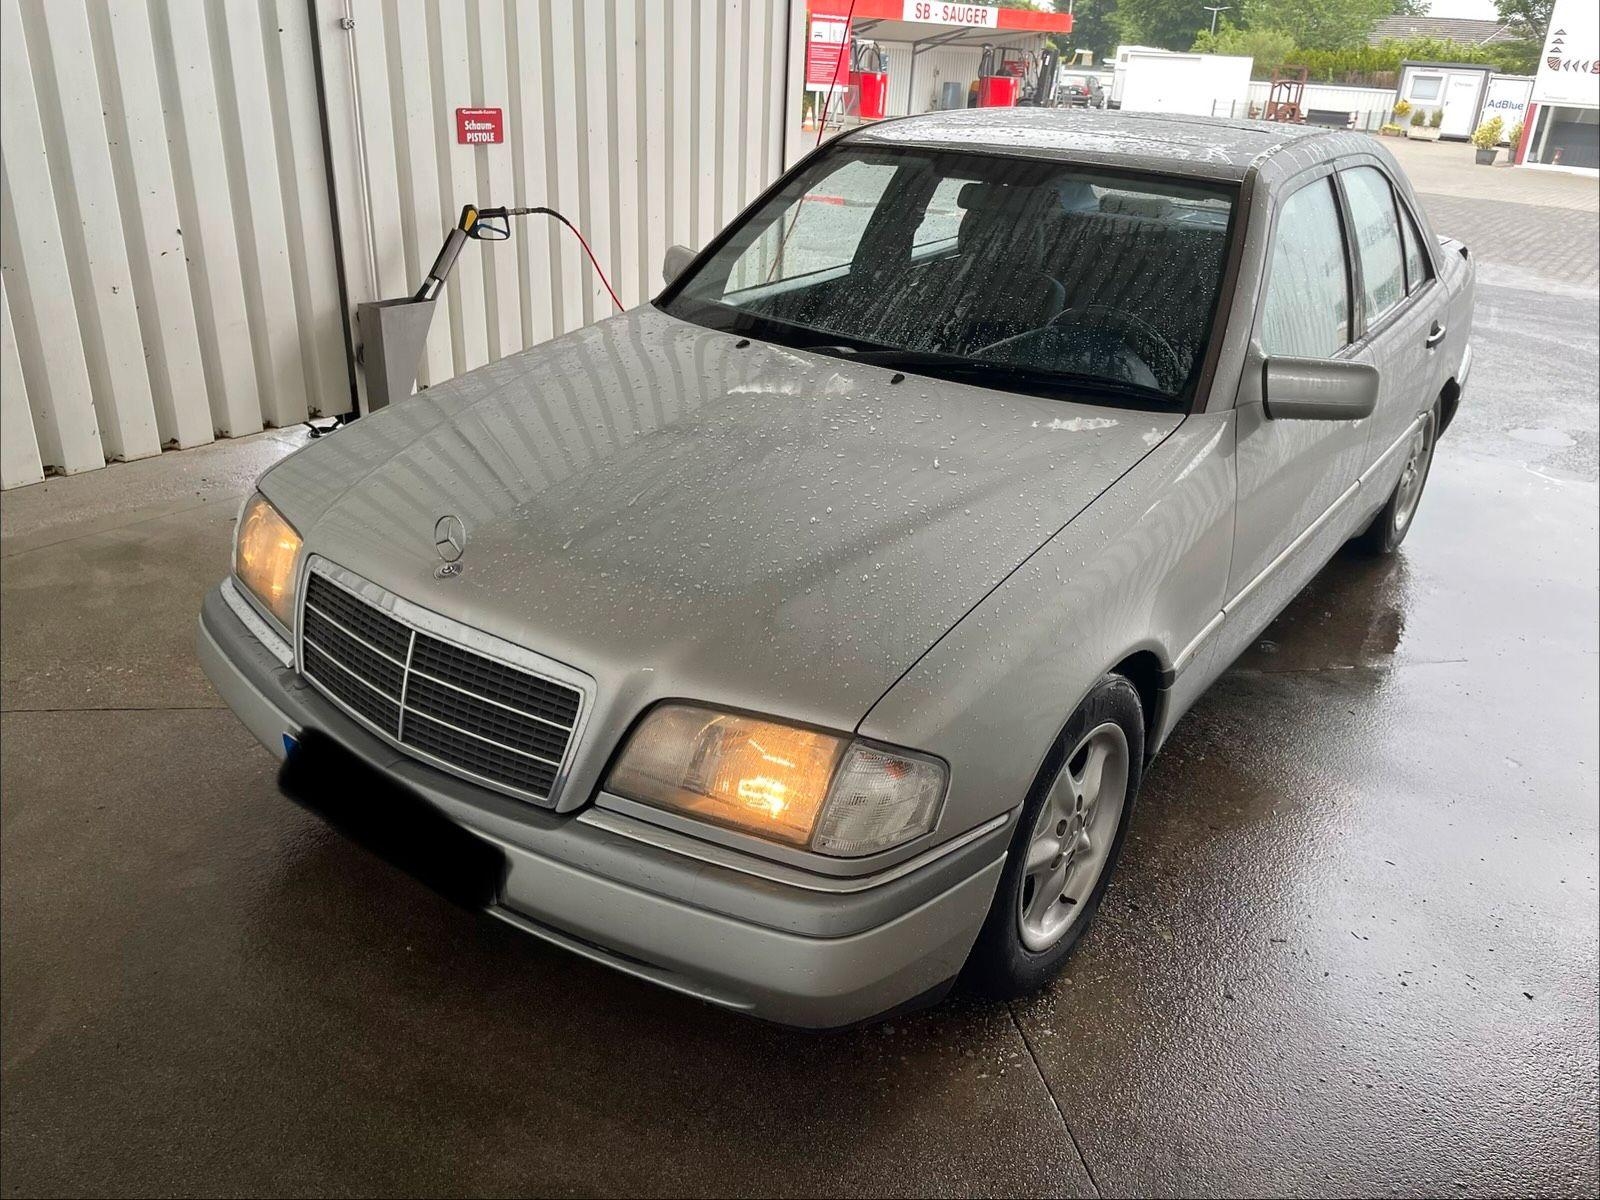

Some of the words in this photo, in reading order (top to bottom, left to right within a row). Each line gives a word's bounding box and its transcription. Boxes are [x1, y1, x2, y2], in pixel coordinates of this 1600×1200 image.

[915, 2, 931, 20] SB
[942, 5, 988, 25] SAUGER
[1487, 99, 1524, 111] AdBlue
[464, 120, 496, 131] Schaum-
[466, 132, 495, 142] PISTOLE
